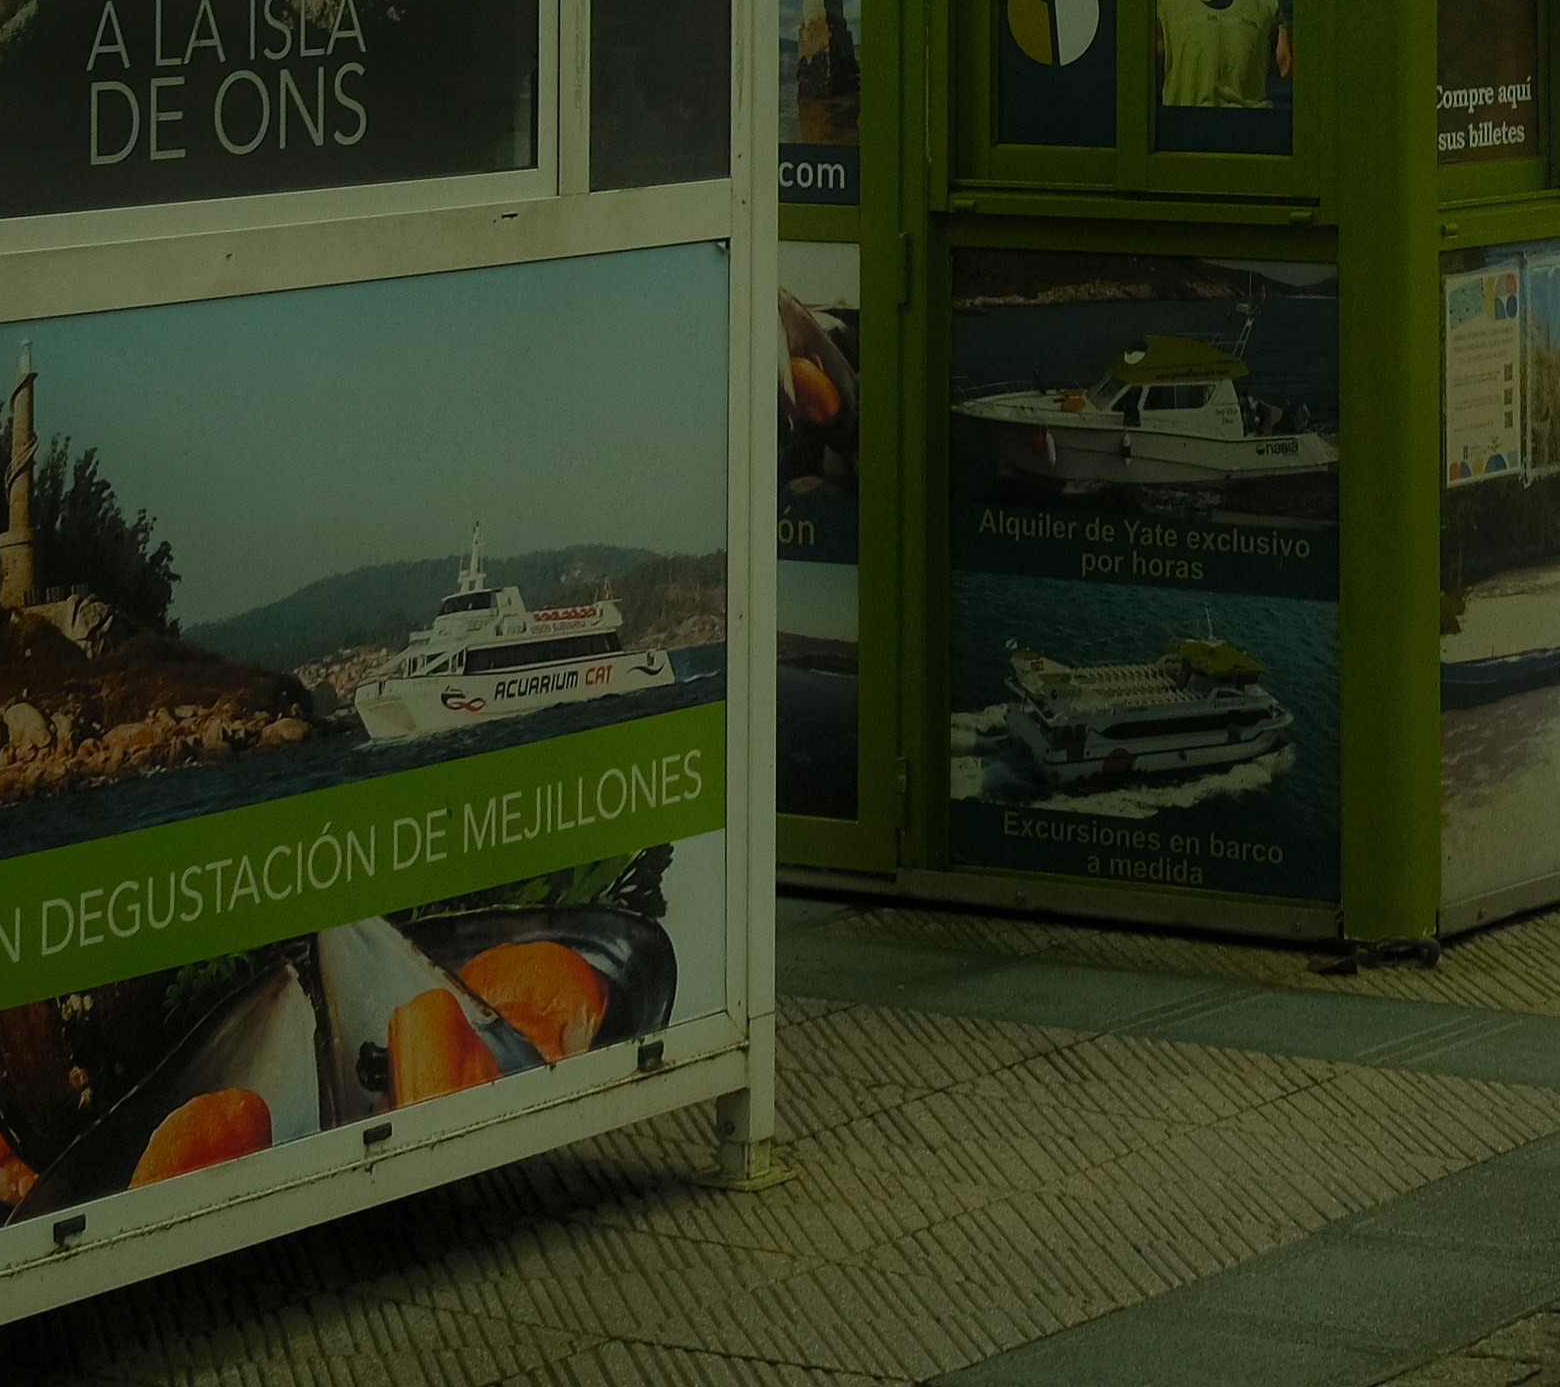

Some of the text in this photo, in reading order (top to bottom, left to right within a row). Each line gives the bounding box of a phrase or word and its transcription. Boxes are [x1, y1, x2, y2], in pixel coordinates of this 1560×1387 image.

[90, 60, 369, 167] DE ONS
[977, 507, 1313, 561] Alquiler de Yate exclusivo
[1079, 549, 1206, 585] por horas
[494, 664, 614, 700] ACUARIUM CAT
[40, 832, 378, 957] DEGUSTACIÓN
[389, 807, 449, 871] DE
[460, 746, 704, 858] MEJILLONES
[1001, 809, 1284, 866] Excursiones en barco
